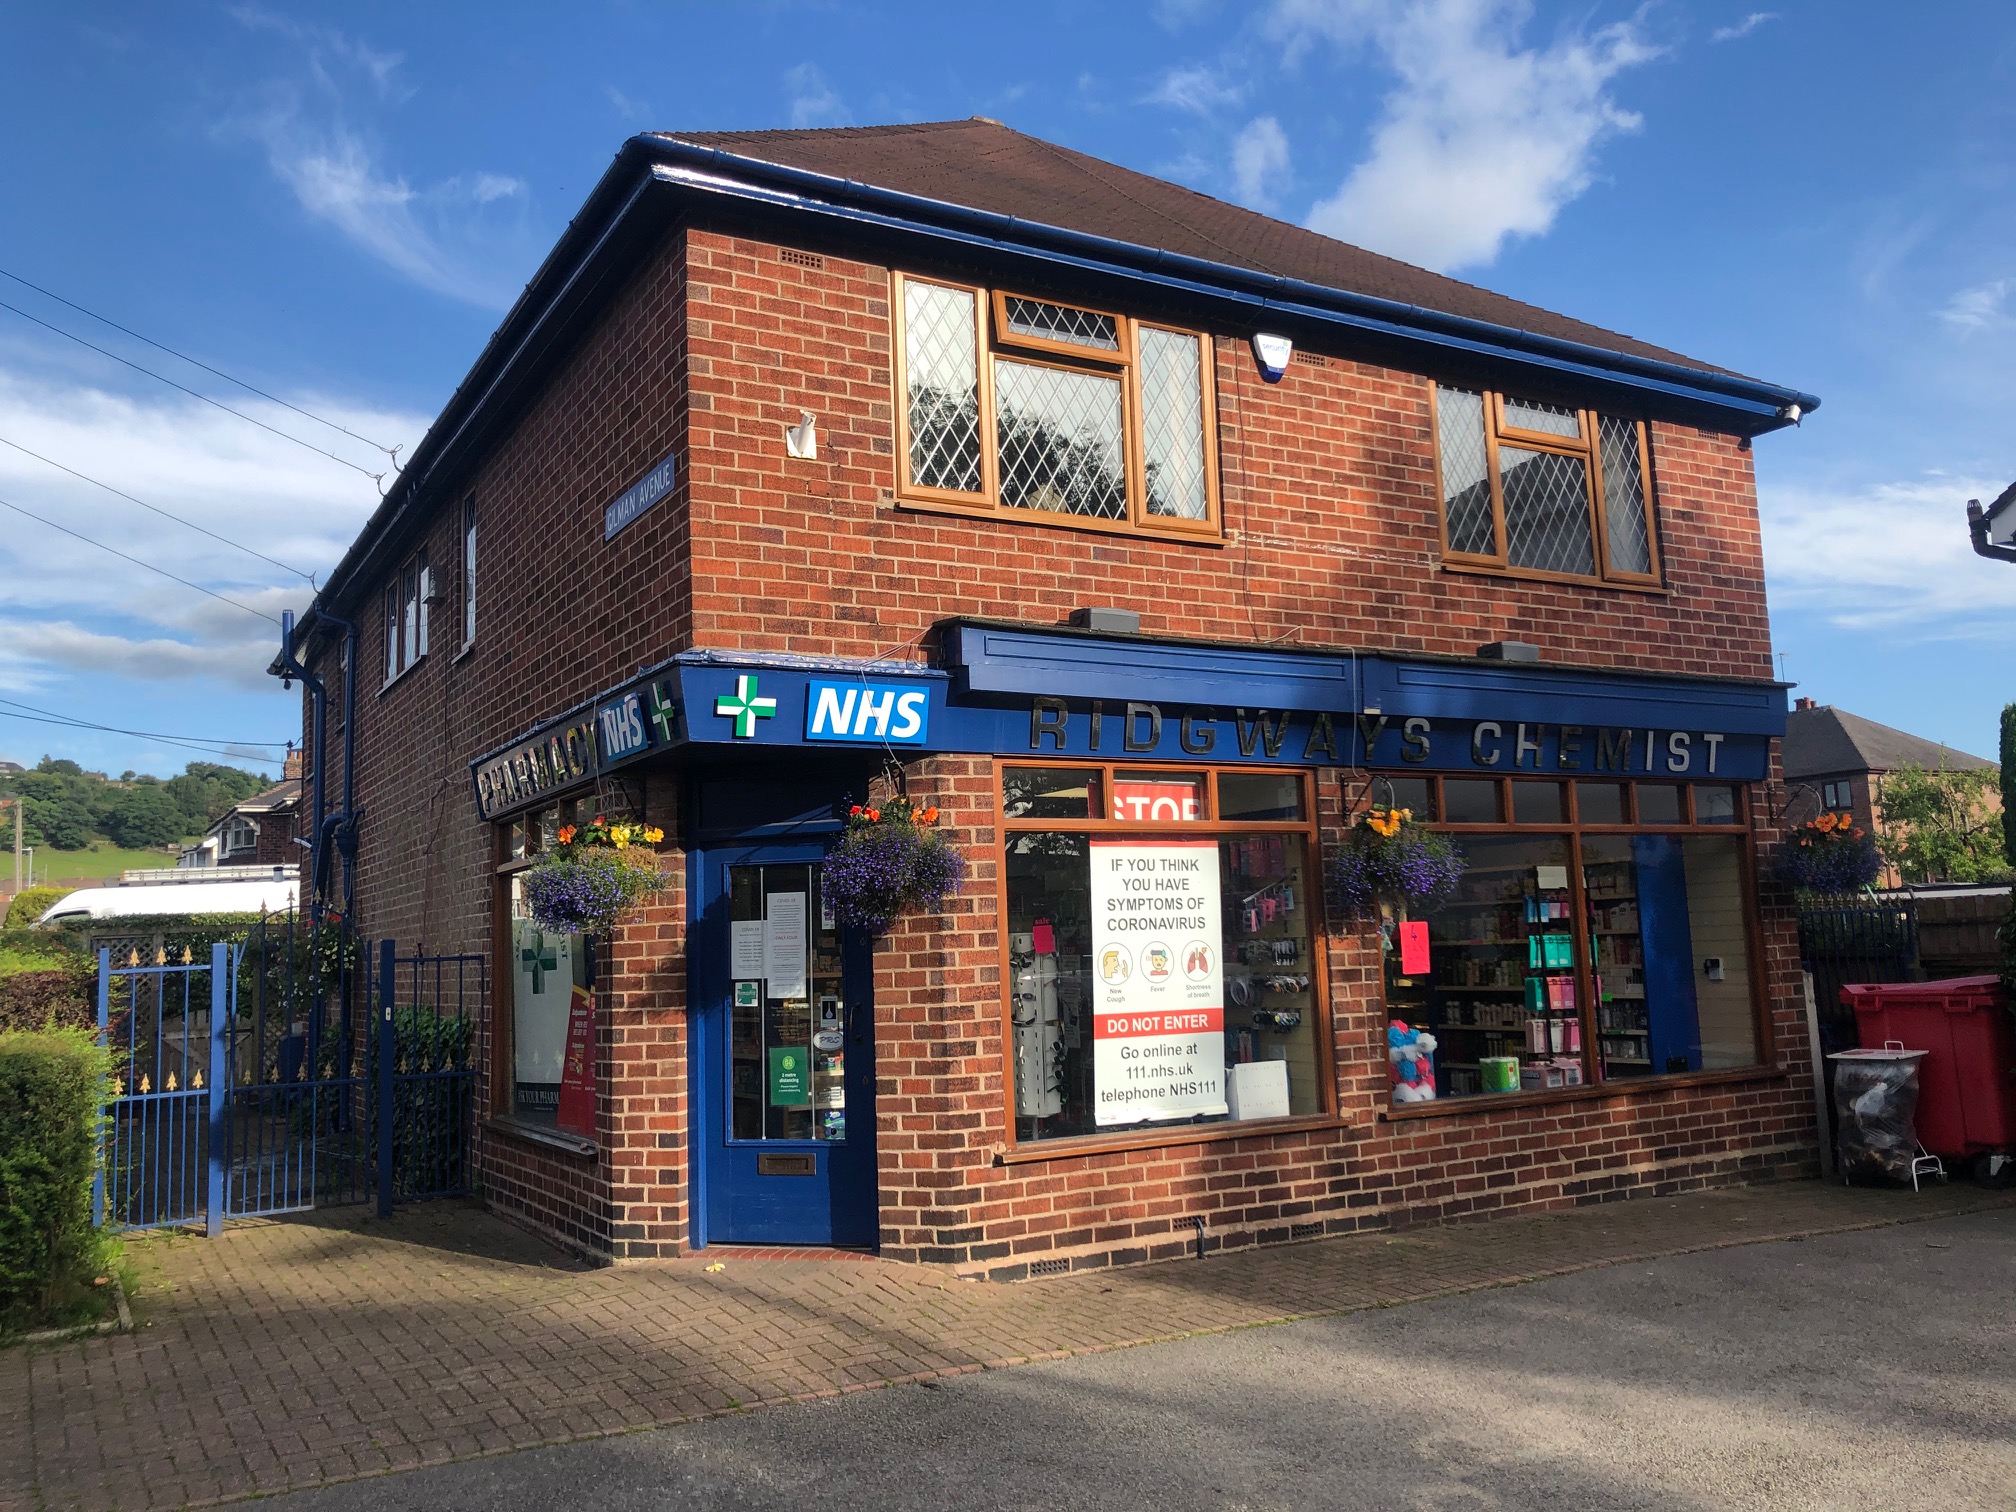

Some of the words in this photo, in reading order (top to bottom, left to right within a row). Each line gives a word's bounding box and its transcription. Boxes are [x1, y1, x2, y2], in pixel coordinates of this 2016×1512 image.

[607, 492, 636, 532] GILMAN
[639, 463, 670, 508] AVENUE
[811, 686, 926, 740] NHS
[1031, 697, 1431, 763] RIDGWAYS
[1473, 721, 1725, 773] CHEMIST
[477, 722, 599, 814] PHARMACY
[602, 702, 643, 757] NHS
[1111, 858, 1123, 871] IF
[1127, 858, 1155, 871] YOU
[1160, 858, 1200, 871] THINK
[1122, 878, 1151, 891] YOU
[1155, 878, 1190, 891] HAVE
[1107, 897, 1183, 911] SYMPTOMS
[1187, 897, 1205, 910] OF
[1034, 917, 1051, 925] sale
[1107, 916, 1206, 931] CORONAVIRUS
[1107, 1019, 1129, 1034] DO
[1132, 1016, 1160, 1032] NOT
[1164, 1013, 1209, 1030] ENTER
[1120, 1046, 1139, 1059] Go
[1143, 1043, 1182, 1057] online
[1186, 1042, 1198, 1055] at
[1126, 1062, 1194, 1079] 111.nhs.uk
[1101, 1086, 1166, 1103] telephone
[1169, 1079, 1216, 1096] NHS111
